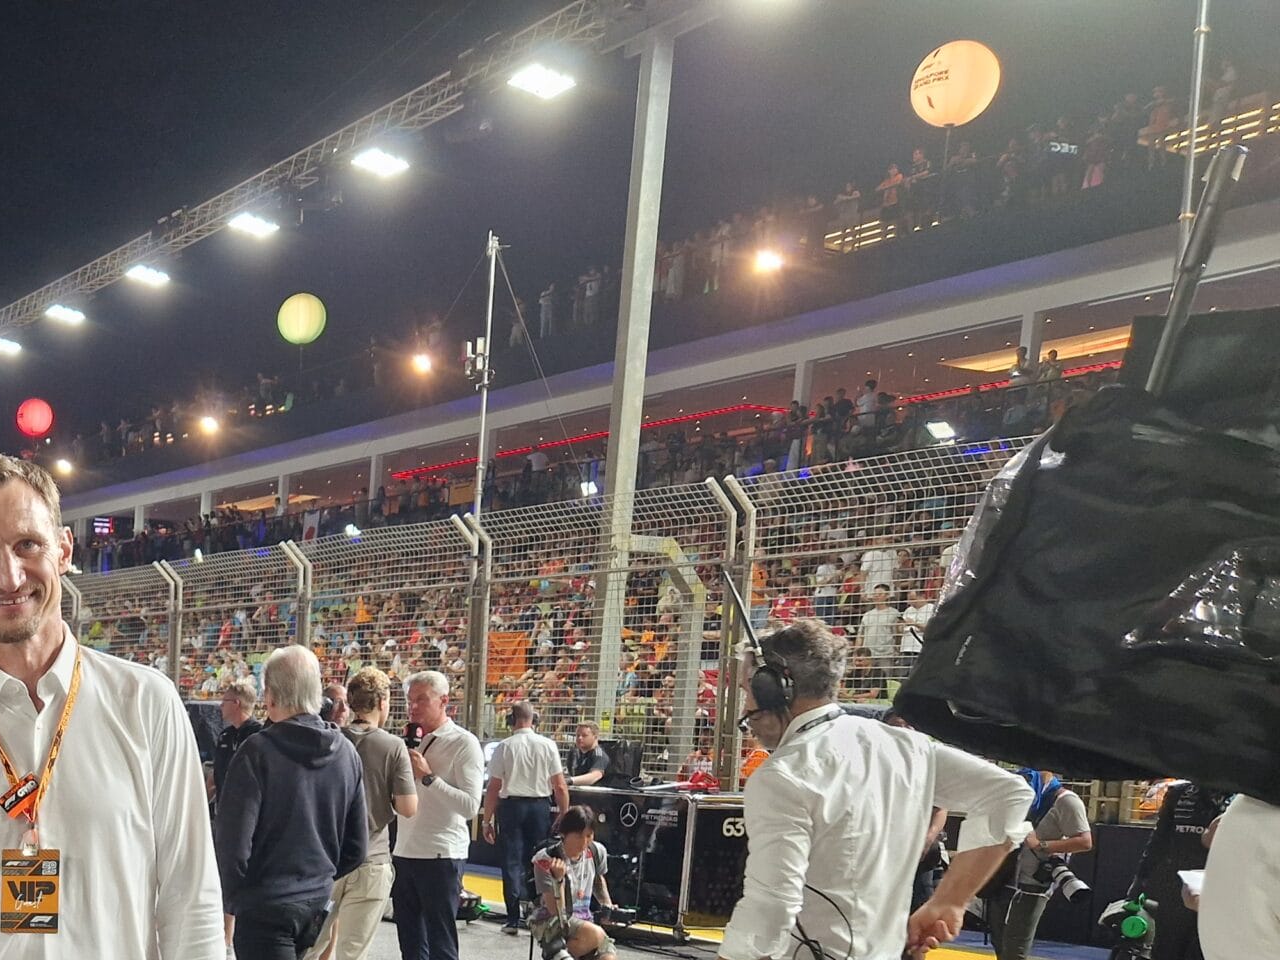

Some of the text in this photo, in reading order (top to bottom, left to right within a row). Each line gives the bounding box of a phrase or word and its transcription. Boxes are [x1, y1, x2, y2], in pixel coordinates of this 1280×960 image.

[722, 817, 745, 837] 63
[1175, 825, 1205, 834] PETRO
[7, 880, 56, 902] VIP
